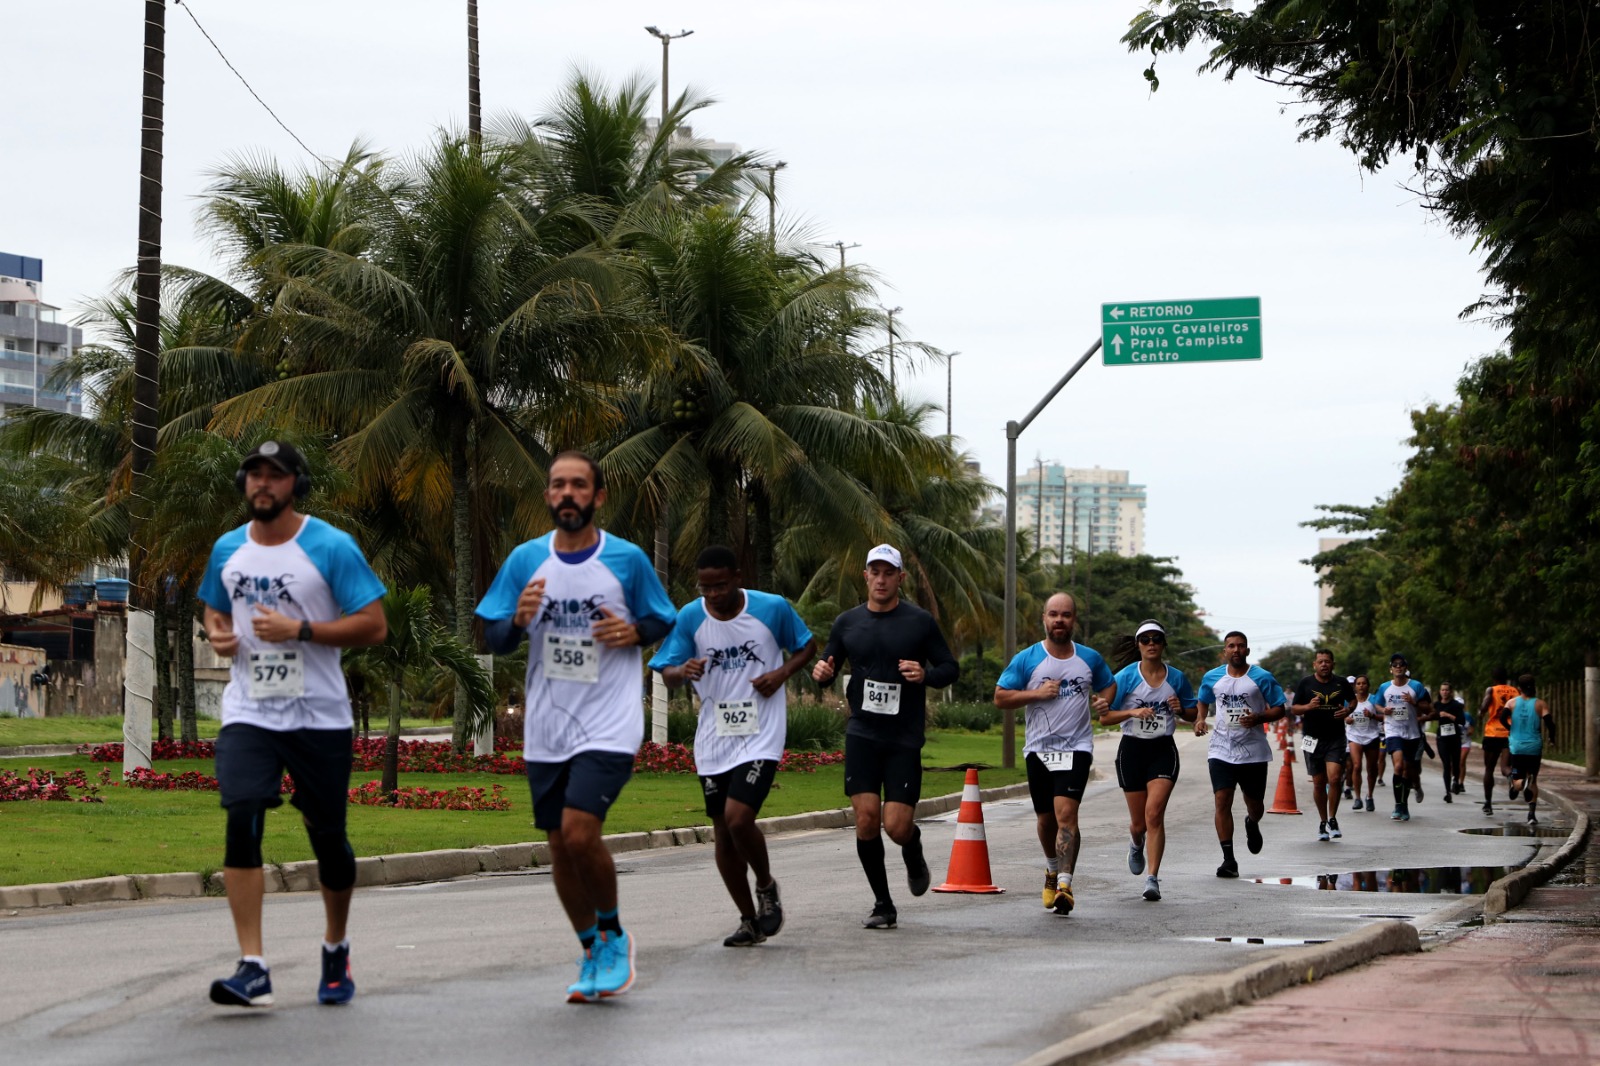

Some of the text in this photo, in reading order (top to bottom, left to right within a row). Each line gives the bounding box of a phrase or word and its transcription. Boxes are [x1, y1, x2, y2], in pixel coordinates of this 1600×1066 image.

[1130, 305, 1193, 318] RETORNO
[1130, 322, 1249, 336] Novo Cavaleiros
[1131, 334, 1243, 349] Praia Campista
[1131, 351, 1179, 362] Centro
[561, 598, 579, 614] 10
[553, 648, 584, 666] 558
[724, 646, 738, 658] 10
[254, 664, 288, 682] 579
[869, 690, 888, 704] 841
[724, 711, 748, 724] 962
[1230, 714, 1245, 722] 77
[1140, 720, 1158, 730] 179
[1043, 752, 1062, 762] 511
